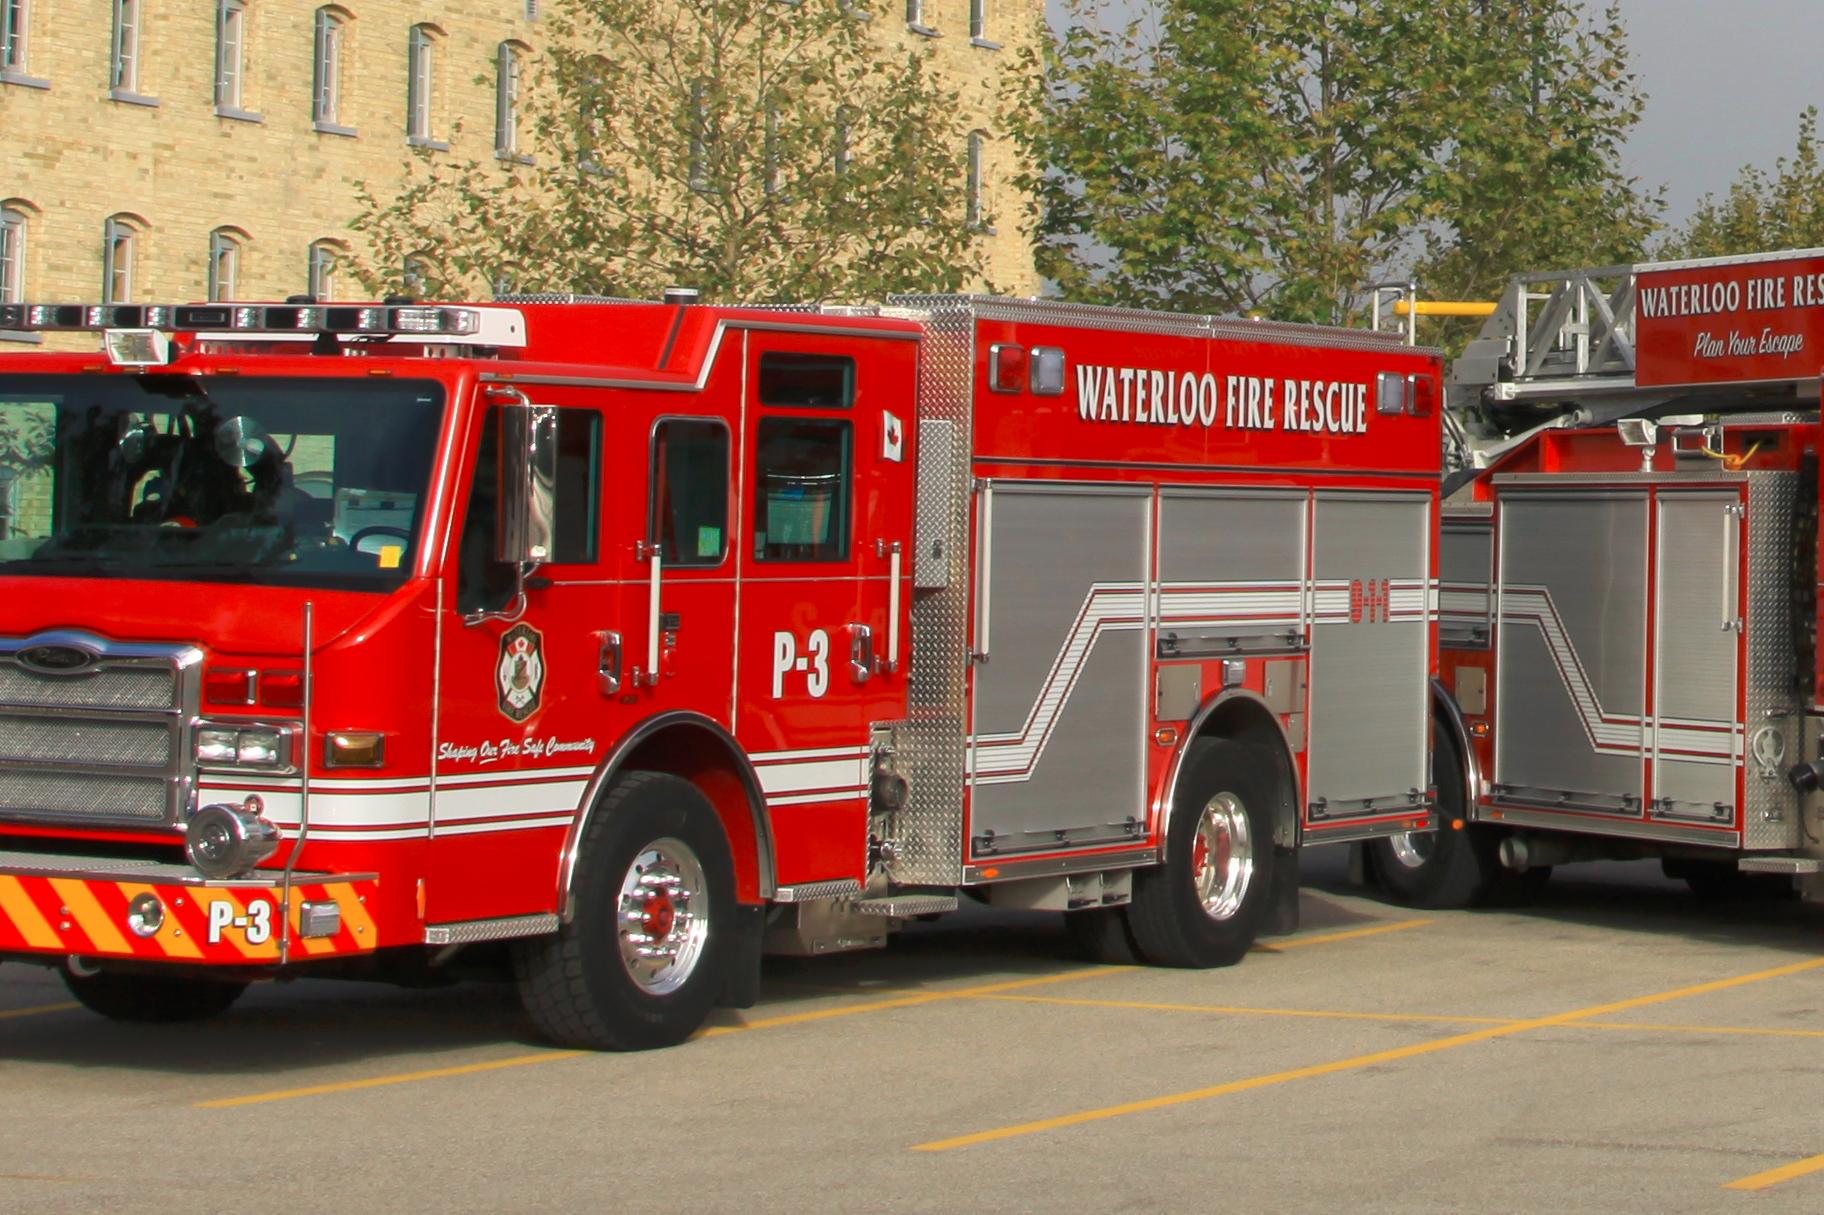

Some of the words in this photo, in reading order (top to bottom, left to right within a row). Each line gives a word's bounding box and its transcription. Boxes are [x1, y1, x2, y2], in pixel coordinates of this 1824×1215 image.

[1641, 281, 1740, 318] WATERLOO
[1747, 277, 1785, 311] FIRE
[1694, 332, 1724, 358] Plan
[1728, 330, 1757, 356] Your
[1758, 327, 1805, 360] Escape
[1076, 364, 1218, 427] WATERLOO
[1225, 375, 1276, 430] FIRE
[1283, 379, 1368, 433] RESCUE
[772, 628, 829, 699] P-3
[437, 742, 478, 763] Shaping
[479, 740, 499, 758] Our
[500, 739, 520, 759] Fire
[522, 737, 545, 759] Safe
[545, 736, 595, 757] Community
[208, 899, 271, 943] P-3
